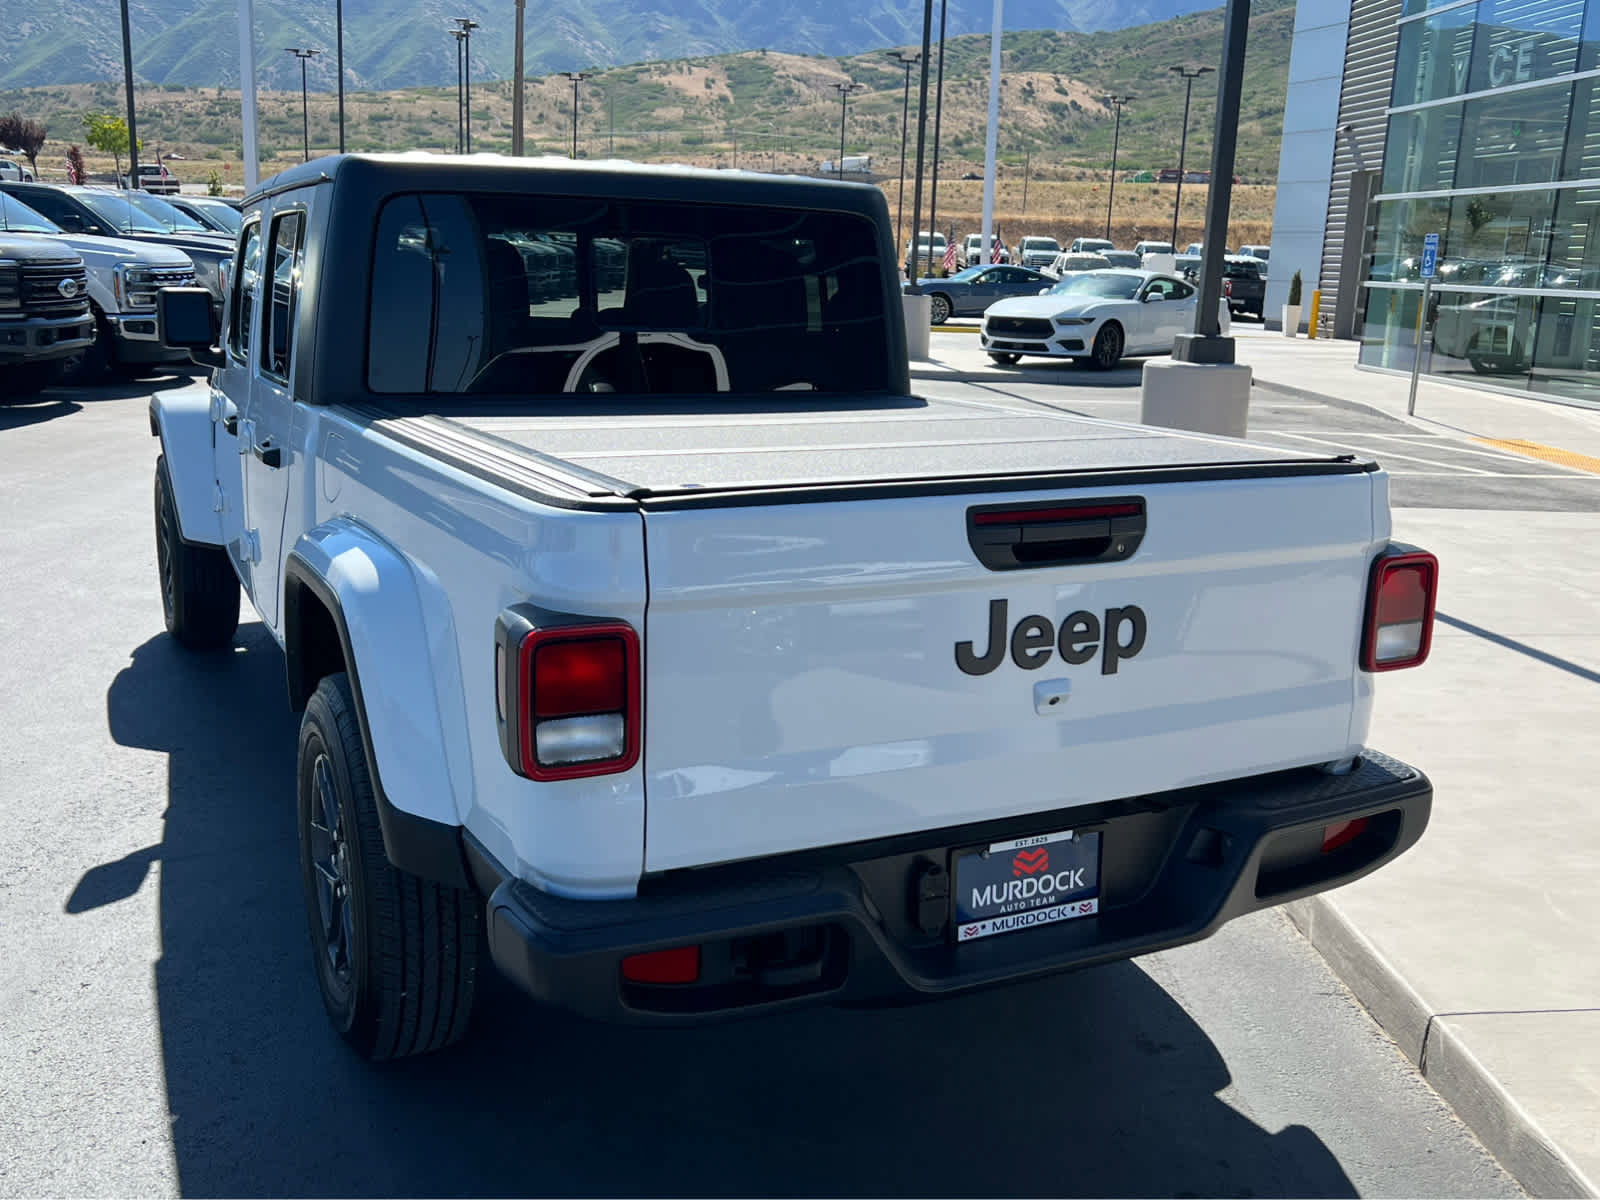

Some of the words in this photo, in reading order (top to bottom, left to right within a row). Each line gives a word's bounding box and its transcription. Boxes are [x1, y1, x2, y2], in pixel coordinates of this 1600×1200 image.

[954, 599, 1147, 676] Jeep
[972, 868, 1085, 908] MURDOCK
[991, 907, 1067, 932] MURDOCK
[1000, 902, 1026, 913] AUTO
[1030, 896, 1056, 907] TEAM
